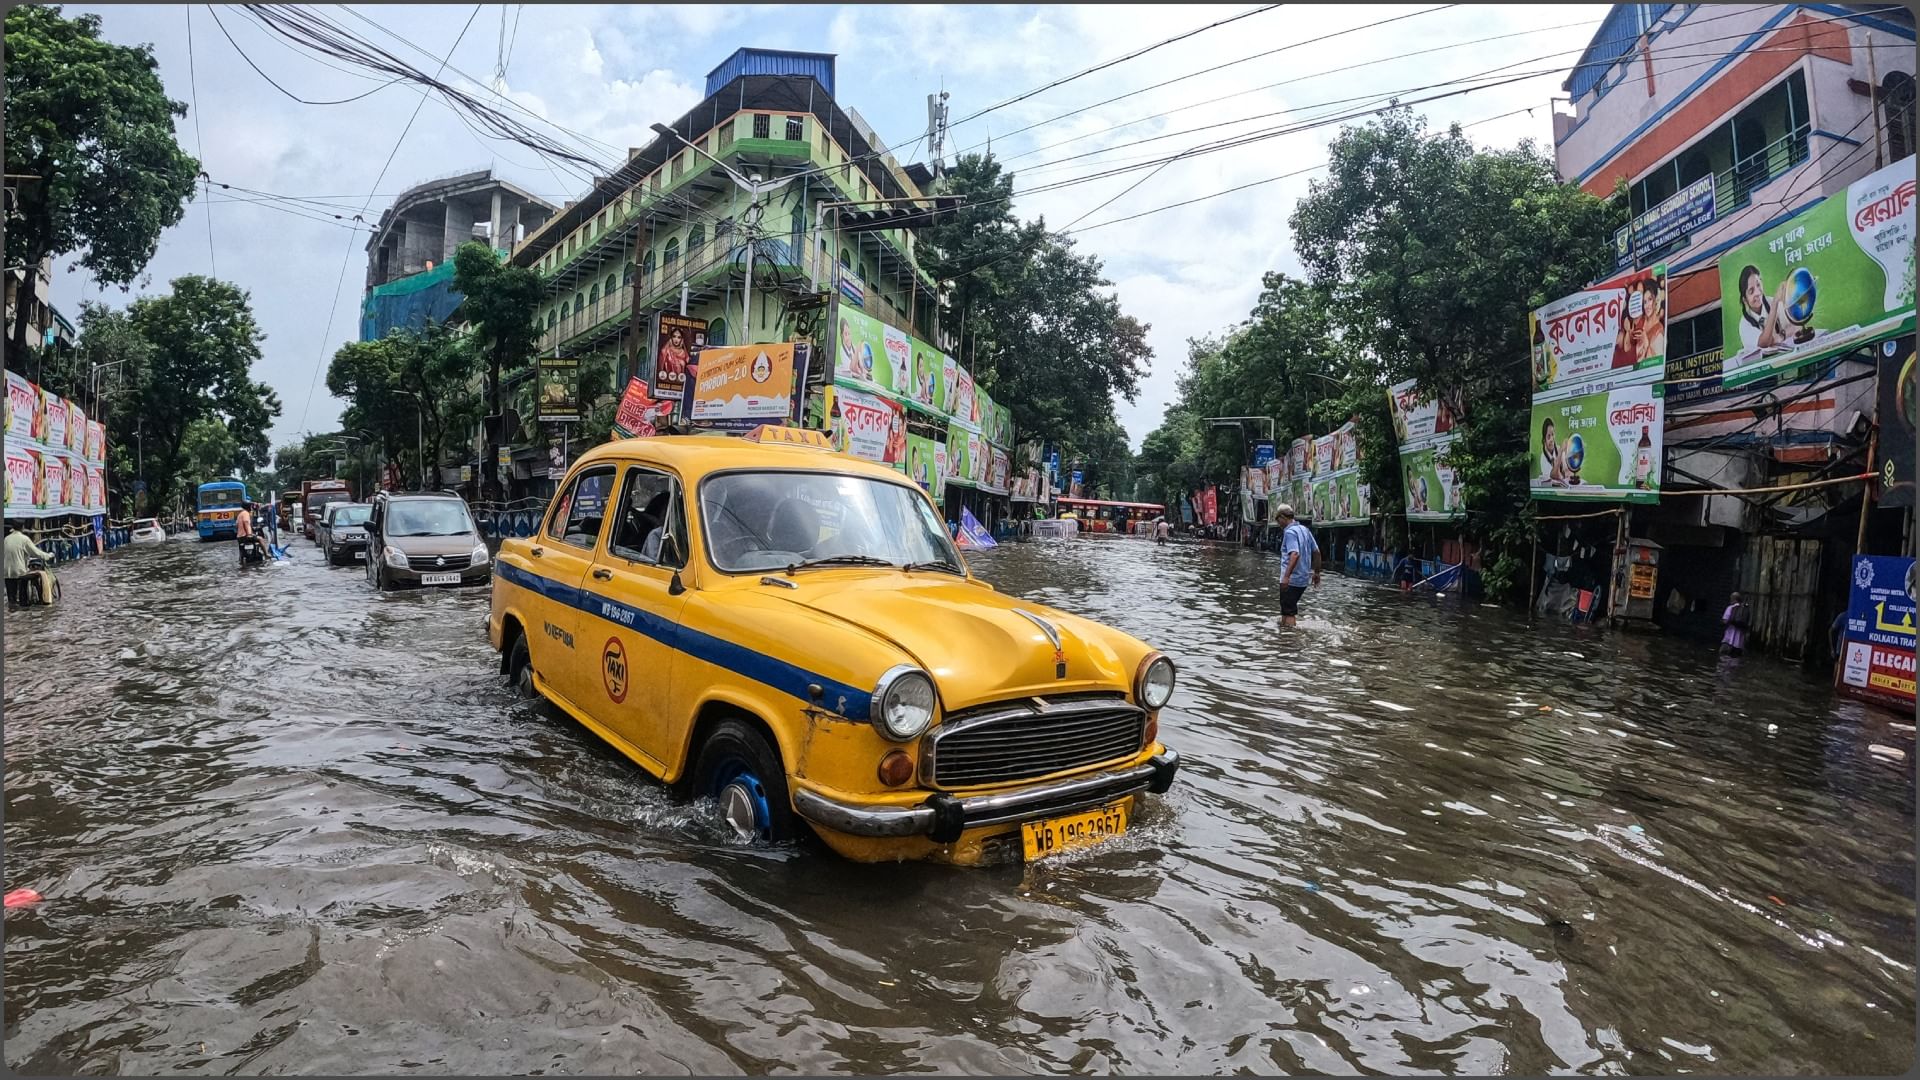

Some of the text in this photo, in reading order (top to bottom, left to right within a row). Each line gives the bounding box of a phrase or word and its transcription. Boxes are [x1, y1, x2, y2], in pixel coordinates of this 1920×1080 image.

[1660, 191, 1690, 217] SECONDARY
[1689, 178, 1712, 201] SCHOOL
[1617, 246, 1651, 268] VOCATONAL
[1651, 228, 1681, 248] TRAINING
[1681, 212, 1712, 234] COLLEGE
[1545, 291, 1624, 356] কুলেরণ
[1666, 350, 1725, 374] TRAL INSTITUTE
[1702, 362, 1724, 374] TECHN
[843, 401, 892, 436] কুলেরণ
[768, 427, 823, 445] TAXI
[1868, 632, 1917, 648] KOLKATA TRAF
[605, 650, 625, 681] TAXI
[1036, 813, 1121, 852] WB 19G 2867
